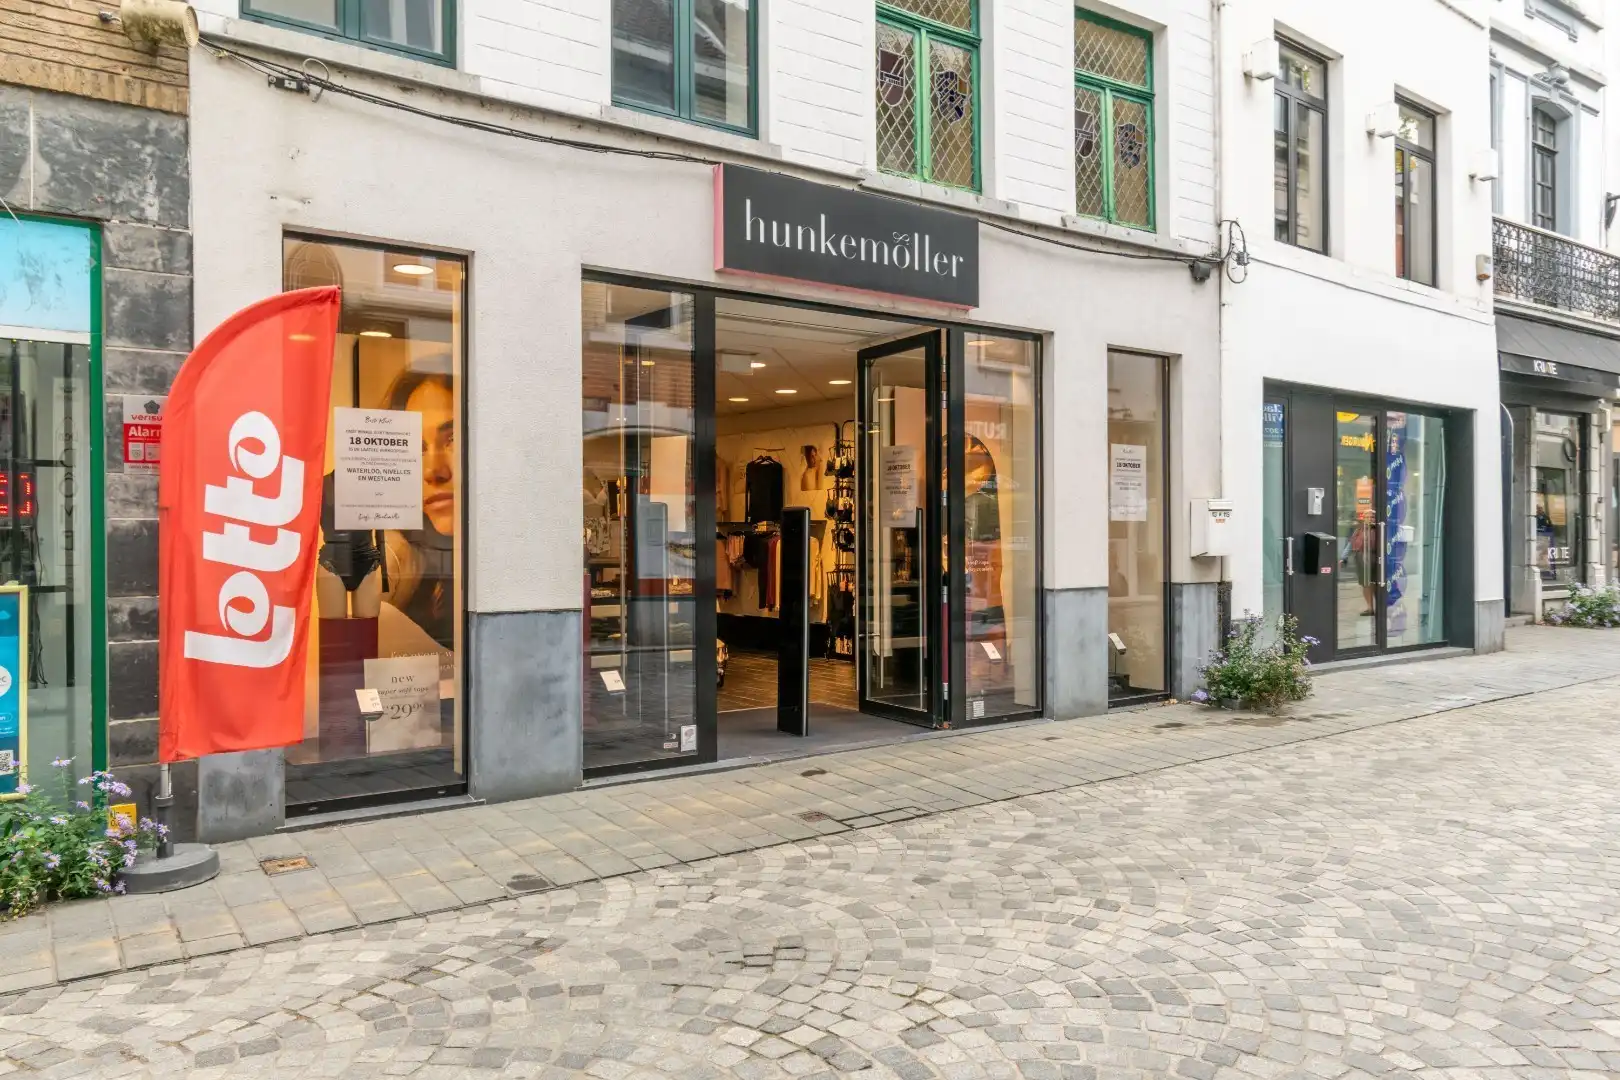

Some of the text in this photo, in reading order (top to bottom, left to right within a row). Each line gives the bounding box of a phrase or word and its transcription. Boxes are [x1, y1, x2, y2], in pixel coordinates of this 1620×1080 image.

[745, 198, 964, 278] hunkemöller
[349, 436, 409, 447] 18 OKTOBER
[183, 410, 305, 669] Lotto
[391, 675, 415, 684] new
